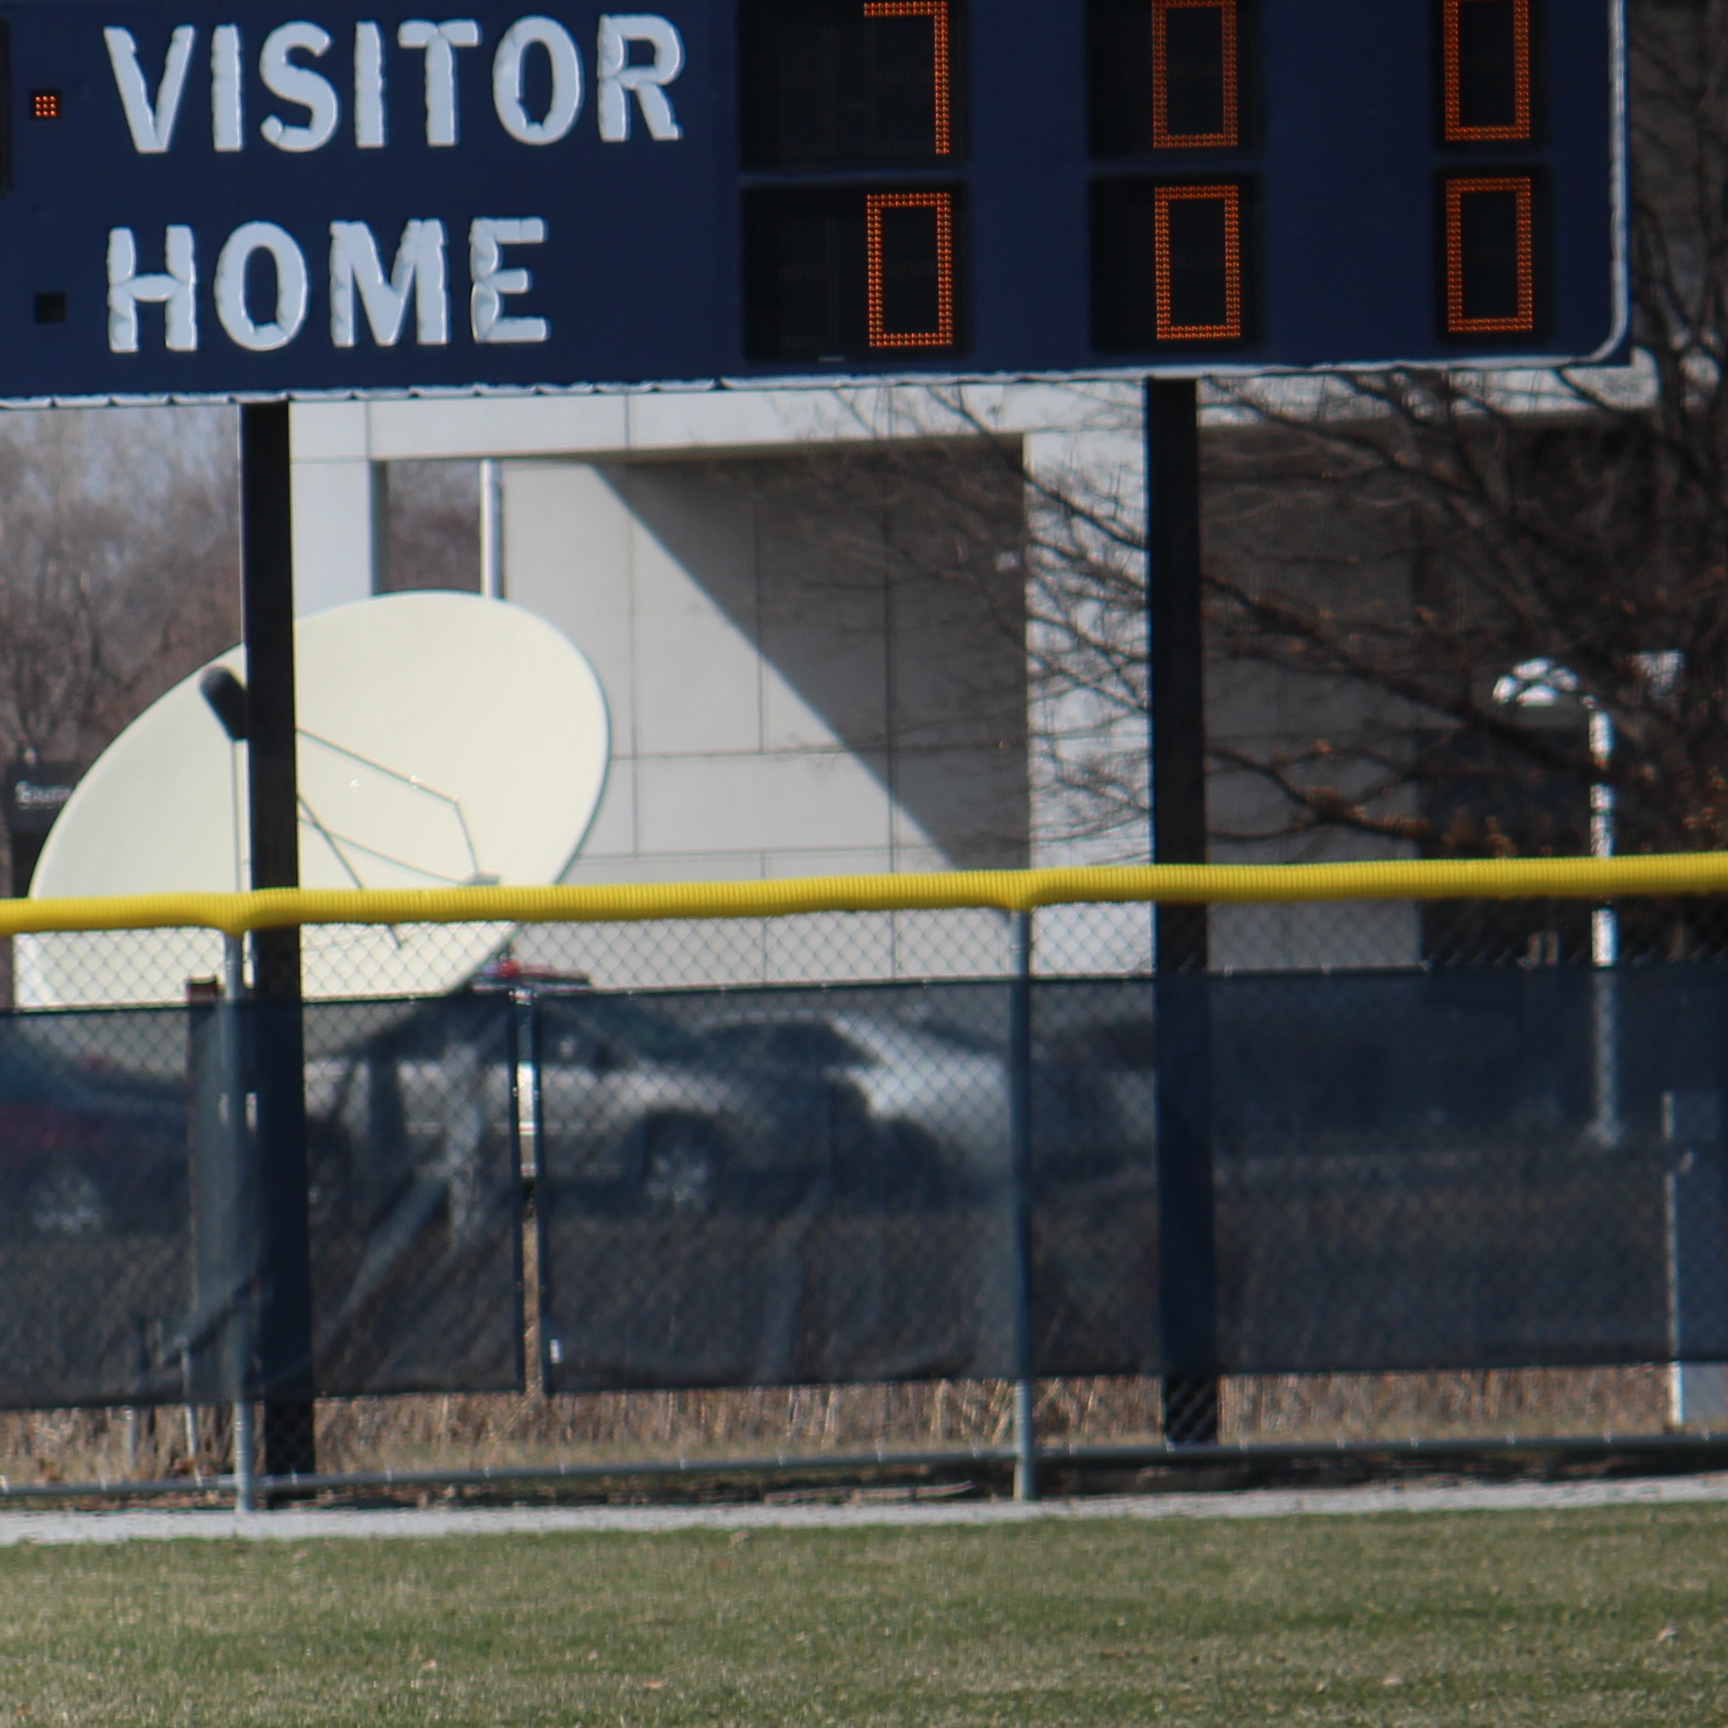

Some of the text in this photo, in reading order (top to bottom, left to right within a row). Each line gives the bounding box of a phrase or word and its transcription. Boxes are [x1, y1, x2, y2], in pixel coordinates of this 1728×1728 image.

[104, 16, 682, 153] VISITOR
[864, 1, 951, 155] 7
[1152, 0, 1237, 148] 0
[107, 218, 549, 352] HOME
[867, 177, 1533, 348] 0 0 0
